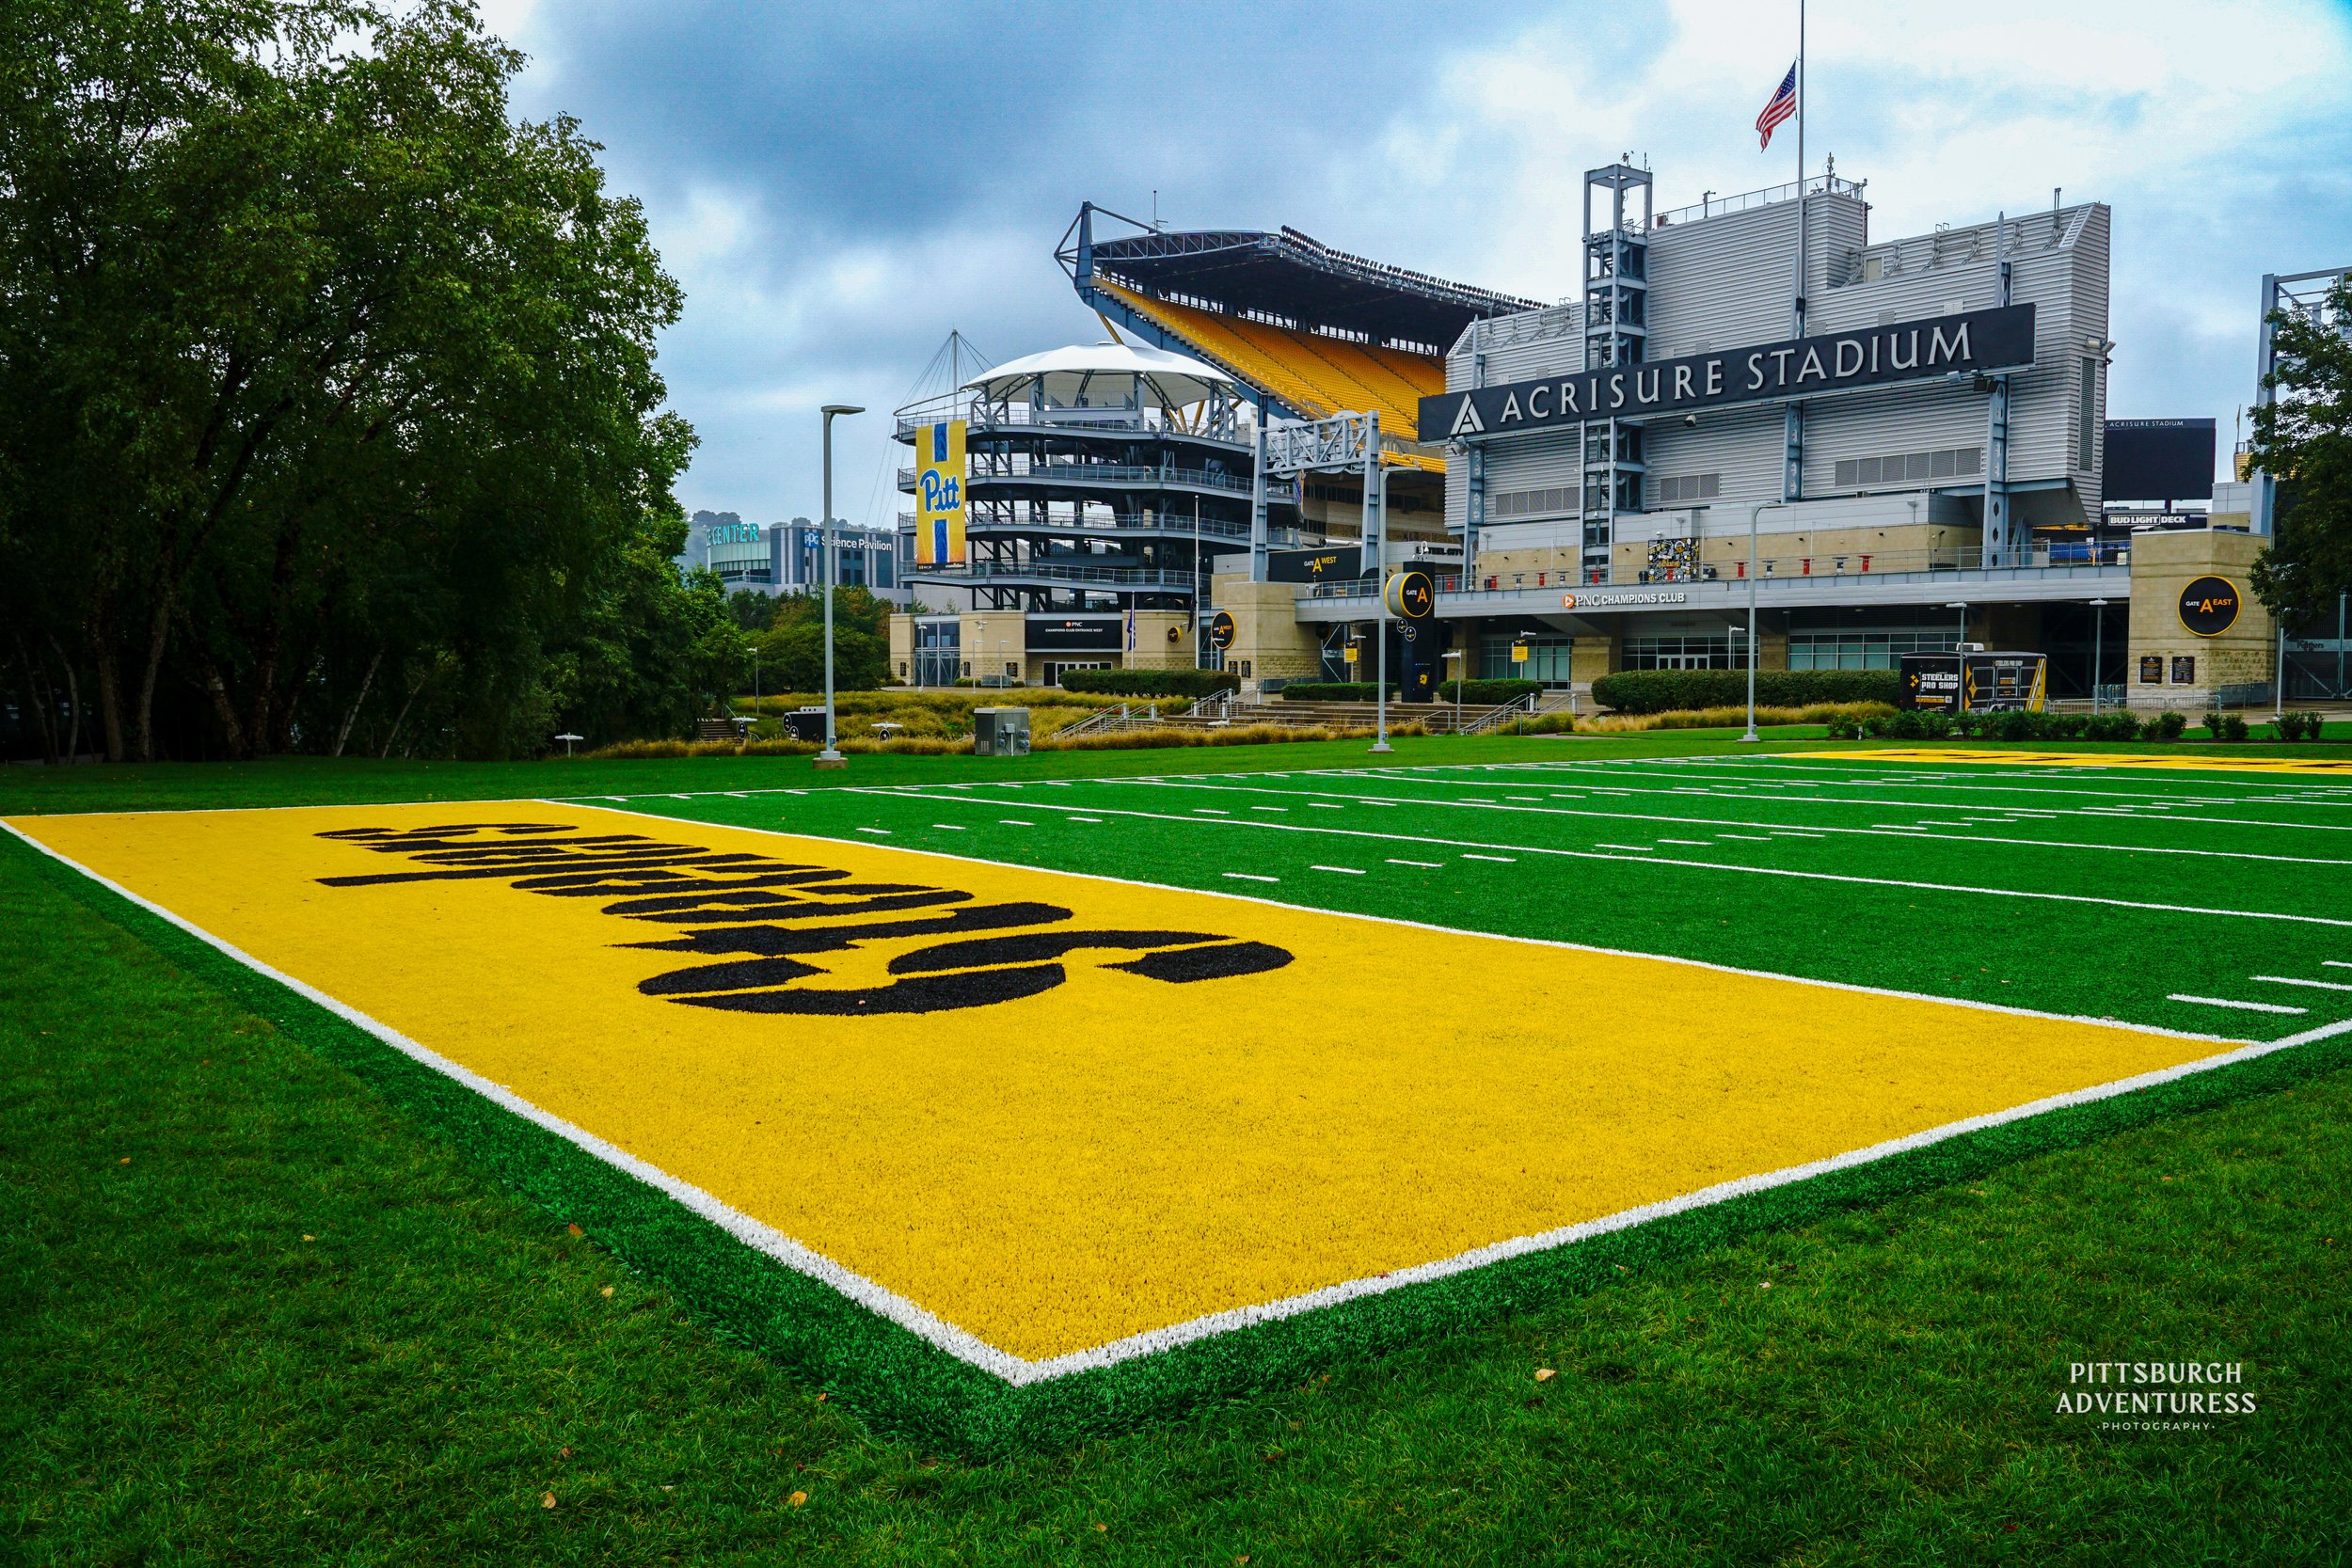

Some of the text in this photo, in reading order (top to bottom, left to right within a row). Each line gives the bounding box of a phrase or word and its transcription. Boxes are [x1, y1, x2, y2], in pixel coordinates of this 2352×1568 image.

[1500, 359, 1724, 423] ACRISURE
[1746, 322, 1973, 390] STADIUM
[919, 468, 961, 513] Pitt
[712, 523, 759, 546] CENTER
[821, 536, 857, 548] Sience
[858, 538, 892, 551] Pavilion
[1312, 557, 1323, 573] A
[1321, 556, 1337, 564] WEST
[1417, 587, 1428, 603] A
[1576, 592, 1685, 607] PNC CHAMPIONS CLUB
[2199, 598, 2214, 613] A
[1218, 626, 1225, 635] A
